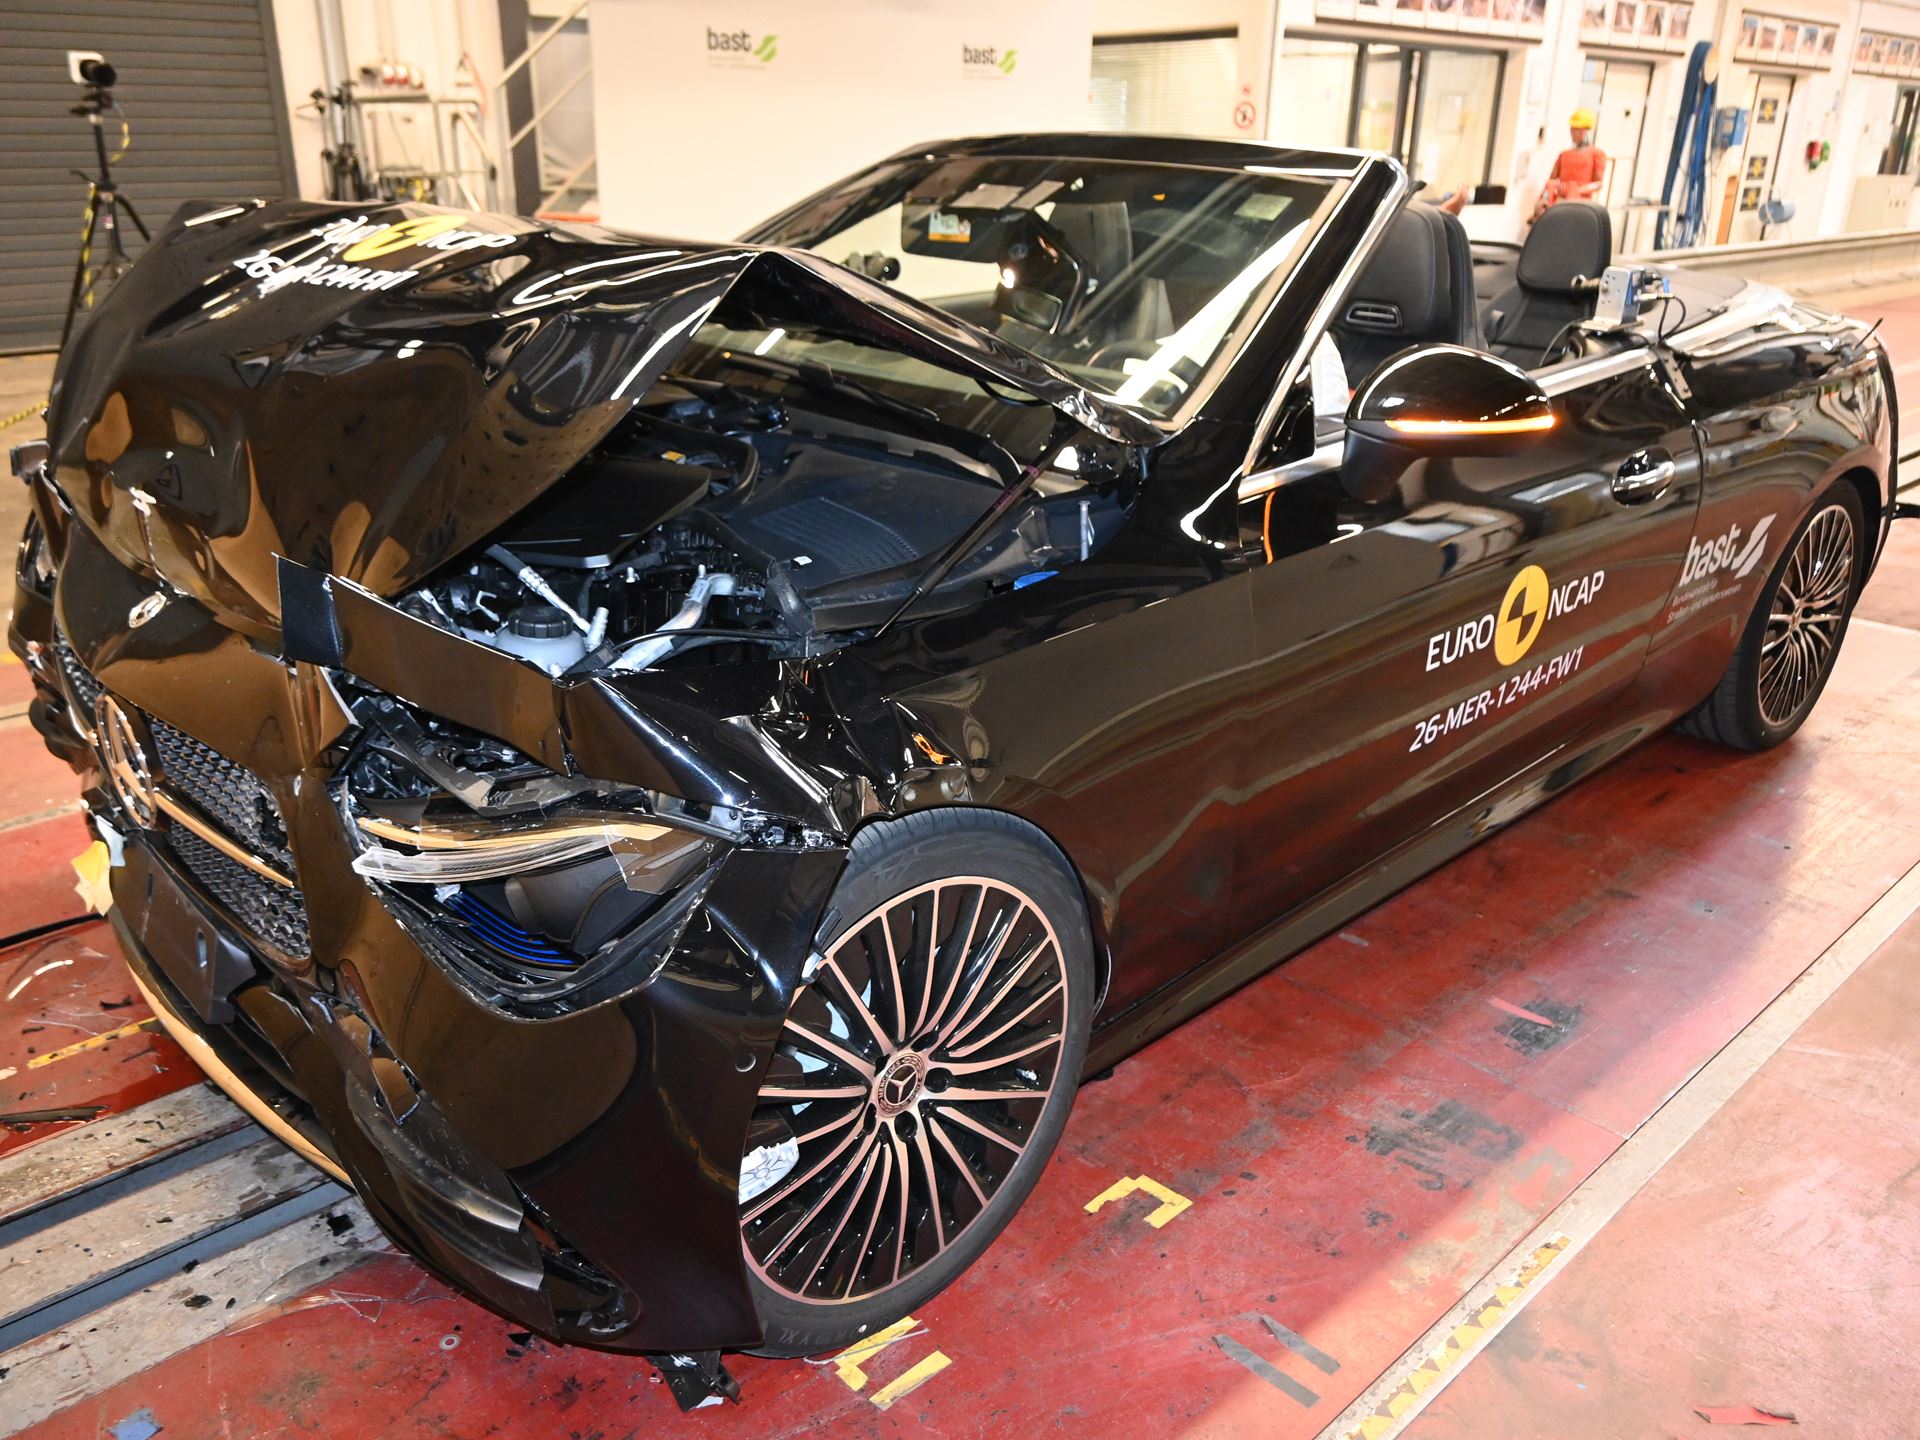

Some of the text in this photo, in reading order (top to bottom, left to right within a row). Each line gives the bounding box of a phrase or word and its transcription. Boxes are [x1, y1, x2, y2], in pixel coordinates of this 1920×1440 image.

[706, 25, 752, 52] bast
[963, 43, 998, 65] bast
[1678, 523, 1741, 588] bast
[1425, 614, 1494, 672] EURO
[1548, 570, 1605, 620] NCAP
[1409, 645, 1584, 752] 26-MER-1244-FW1
